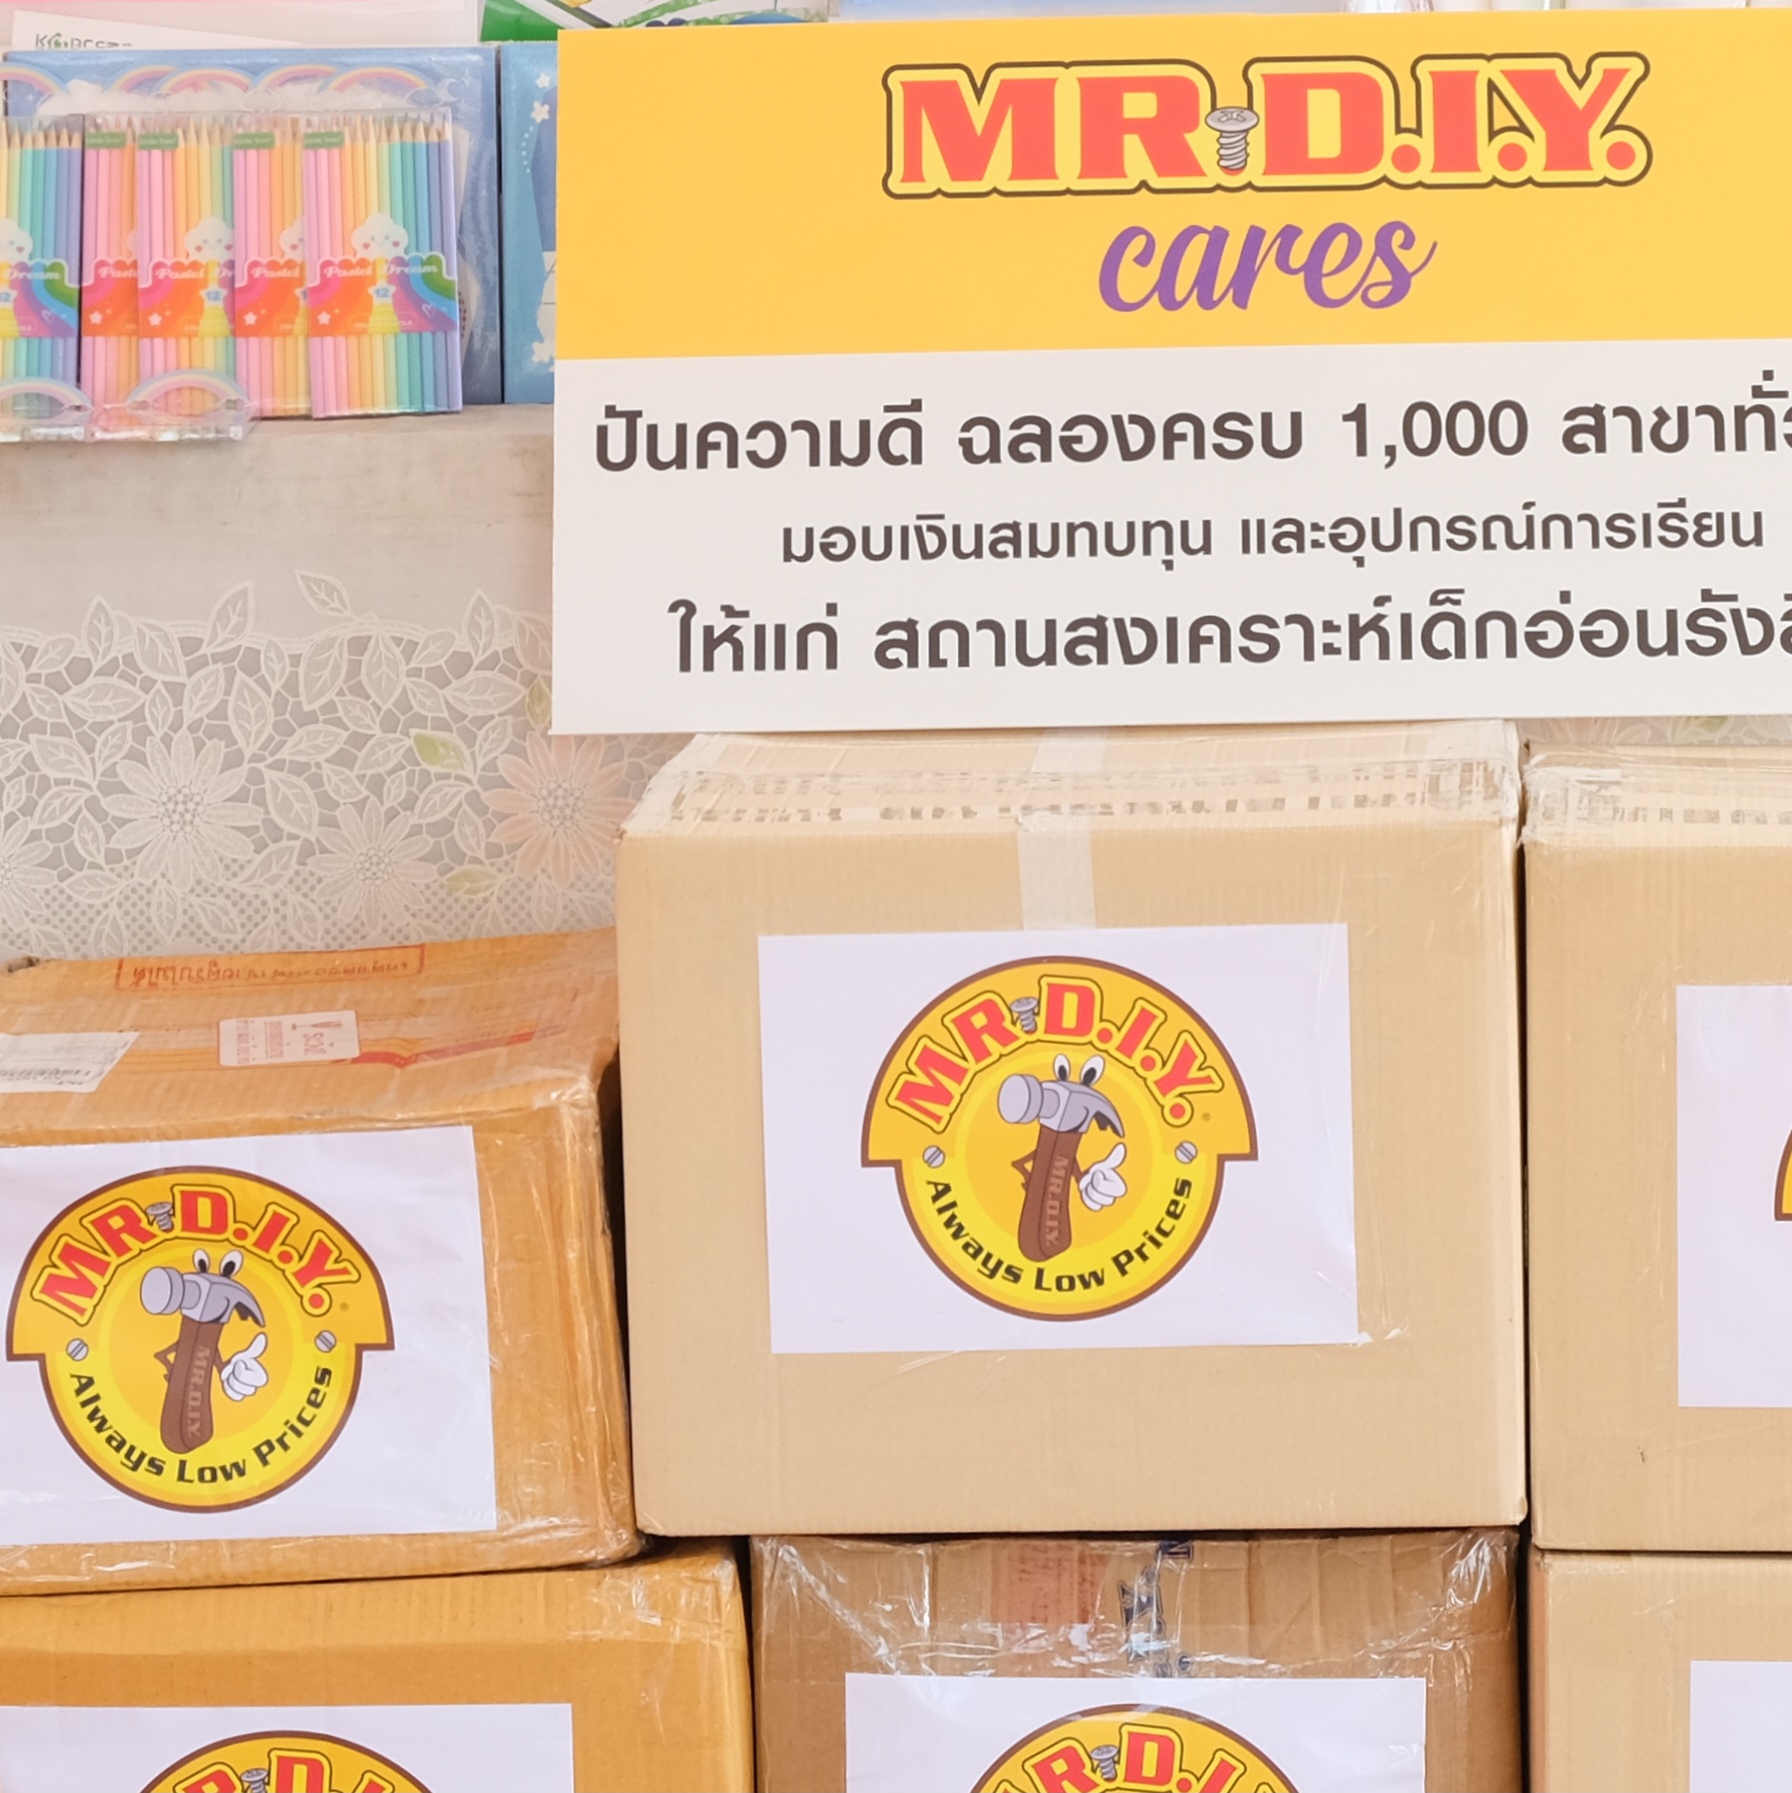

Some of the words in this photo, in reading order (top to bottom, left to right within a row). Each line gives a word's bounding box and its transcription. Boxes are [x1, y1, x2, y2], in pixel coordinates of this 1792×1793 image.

[1099, 220, 1438, 312] cares
[595, 399, 924, 473] ปันความดี
[956, 405, 1302, 466] ฉลองครบ
[1342, 399, 1528, 470] 1,000
[781, 510, 1213, 572] มอบเงินสมทบทุน
[1239, 502, 1765, 569] และอุปกรณ์การเรียน
[668, 600, 839, 675] ให้แก่
[925, 1178, 1024, 1285] Always
[1034, 1266, 1106, 1292] Low
[1111, 1176, 1192, 1278] Prices
[69, 1372, 165, 1477] Always
[176, 1458, 247, 1484] Low
[252, 1366, 333, 1468] Prices
